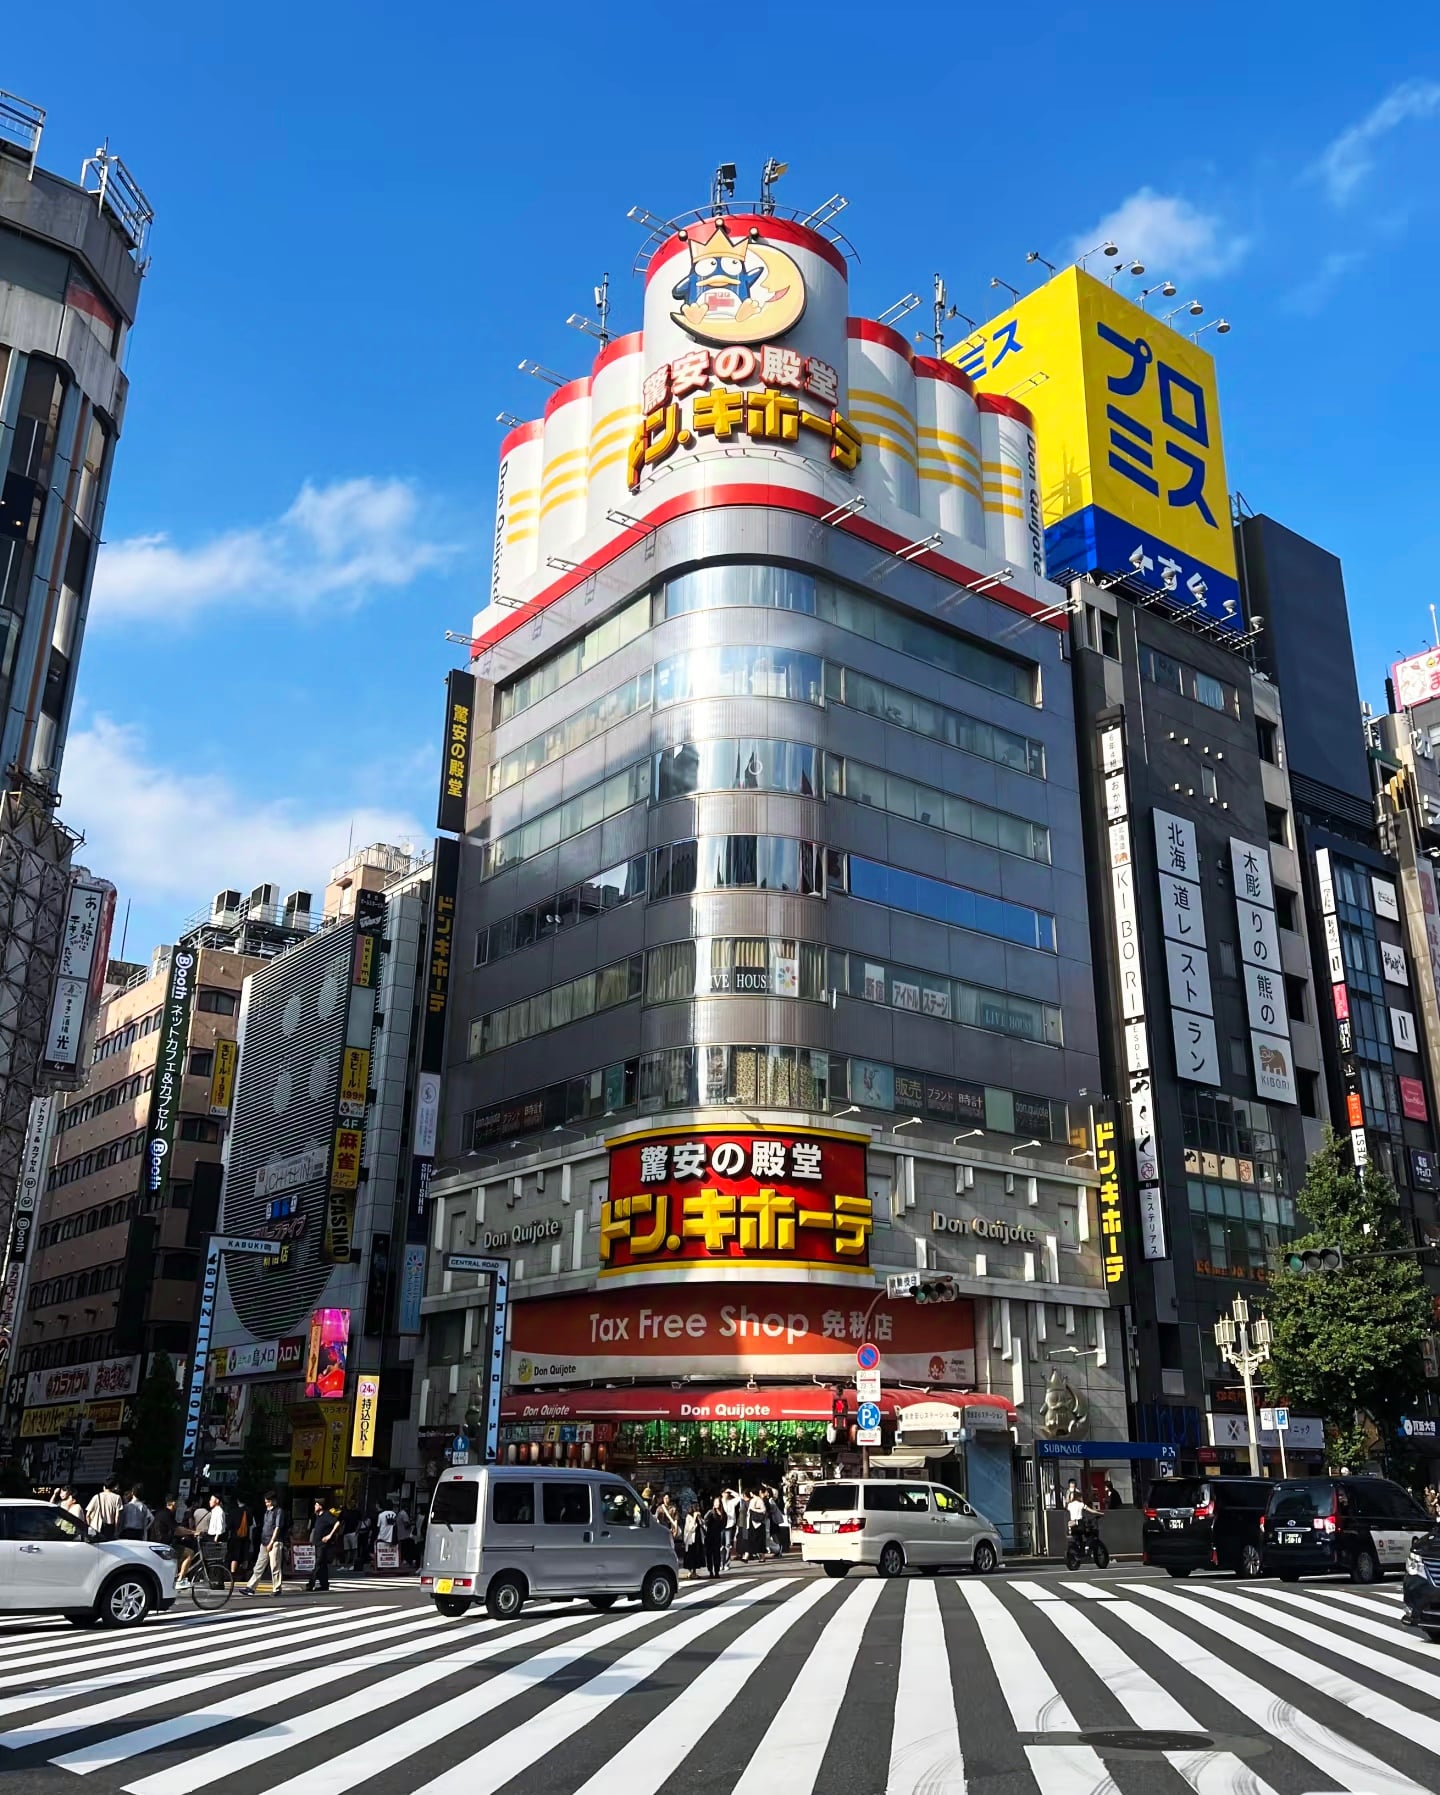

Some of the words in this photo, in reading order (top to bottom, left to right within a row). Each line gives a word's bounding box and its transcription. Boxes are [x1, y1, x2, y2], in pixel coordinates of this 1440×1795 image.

[643, 345, 839, 415] 驚安の殿堂
[1026, 432, 1038, 475] Don
[447, 704, 469, 798] 驚安の殿堂
[1116, 870, 1136, 1012] KIBORI
[1166, 821, 1206, 1074] 北海道レストラン
[173, 951, 194, 1000] Booth
[709, 974, 730, 989] IVE
[1260, 1075, 1290, 1091] KIBORI
[342, 1118, 359, 1129] 4F
[336, 1132, 358, 1171] 麻雀
[640, 1140, 823, 1183] 驚安の殿堂
[484, 1230, 507, 1250] Don
[511, 1219, 561, 1245] Quijote
[932, 1210, 968, 1234] Don
[971, 1216, 1037, 1245] Quijote
[1146, 1191, 1159, 1255] ミステリアス
[450, 1258, 480, 1269] CENTRAL
[481, 1260, 500, 1270] ROAD
[193, 1266, 218, 1373] GODZILLA
[589, 1312, 629, 1343] Tax
[639, 1309, 707, 1340] Free
[719, 1305, 809, 1344] Shop
[821, 1309, 893, 1342] 免税店
[534, 1364, 548, 1377] Don
[550, 1363, 577, 1376] Quijote
[9, 1377, 25, 1404] 3F
[184, 1384, 202, 1437] ROAD
[523, 1405, 538, 1417] Don
[539, 1404, 570, 1419] Quijote
[680, 1404, 711, 1416] Don
[714, 1403, 771, 1419] Quijote
[862, 1408, 871, 1426] P
[1043, 1443, 1083, 1455] SUBNADE
